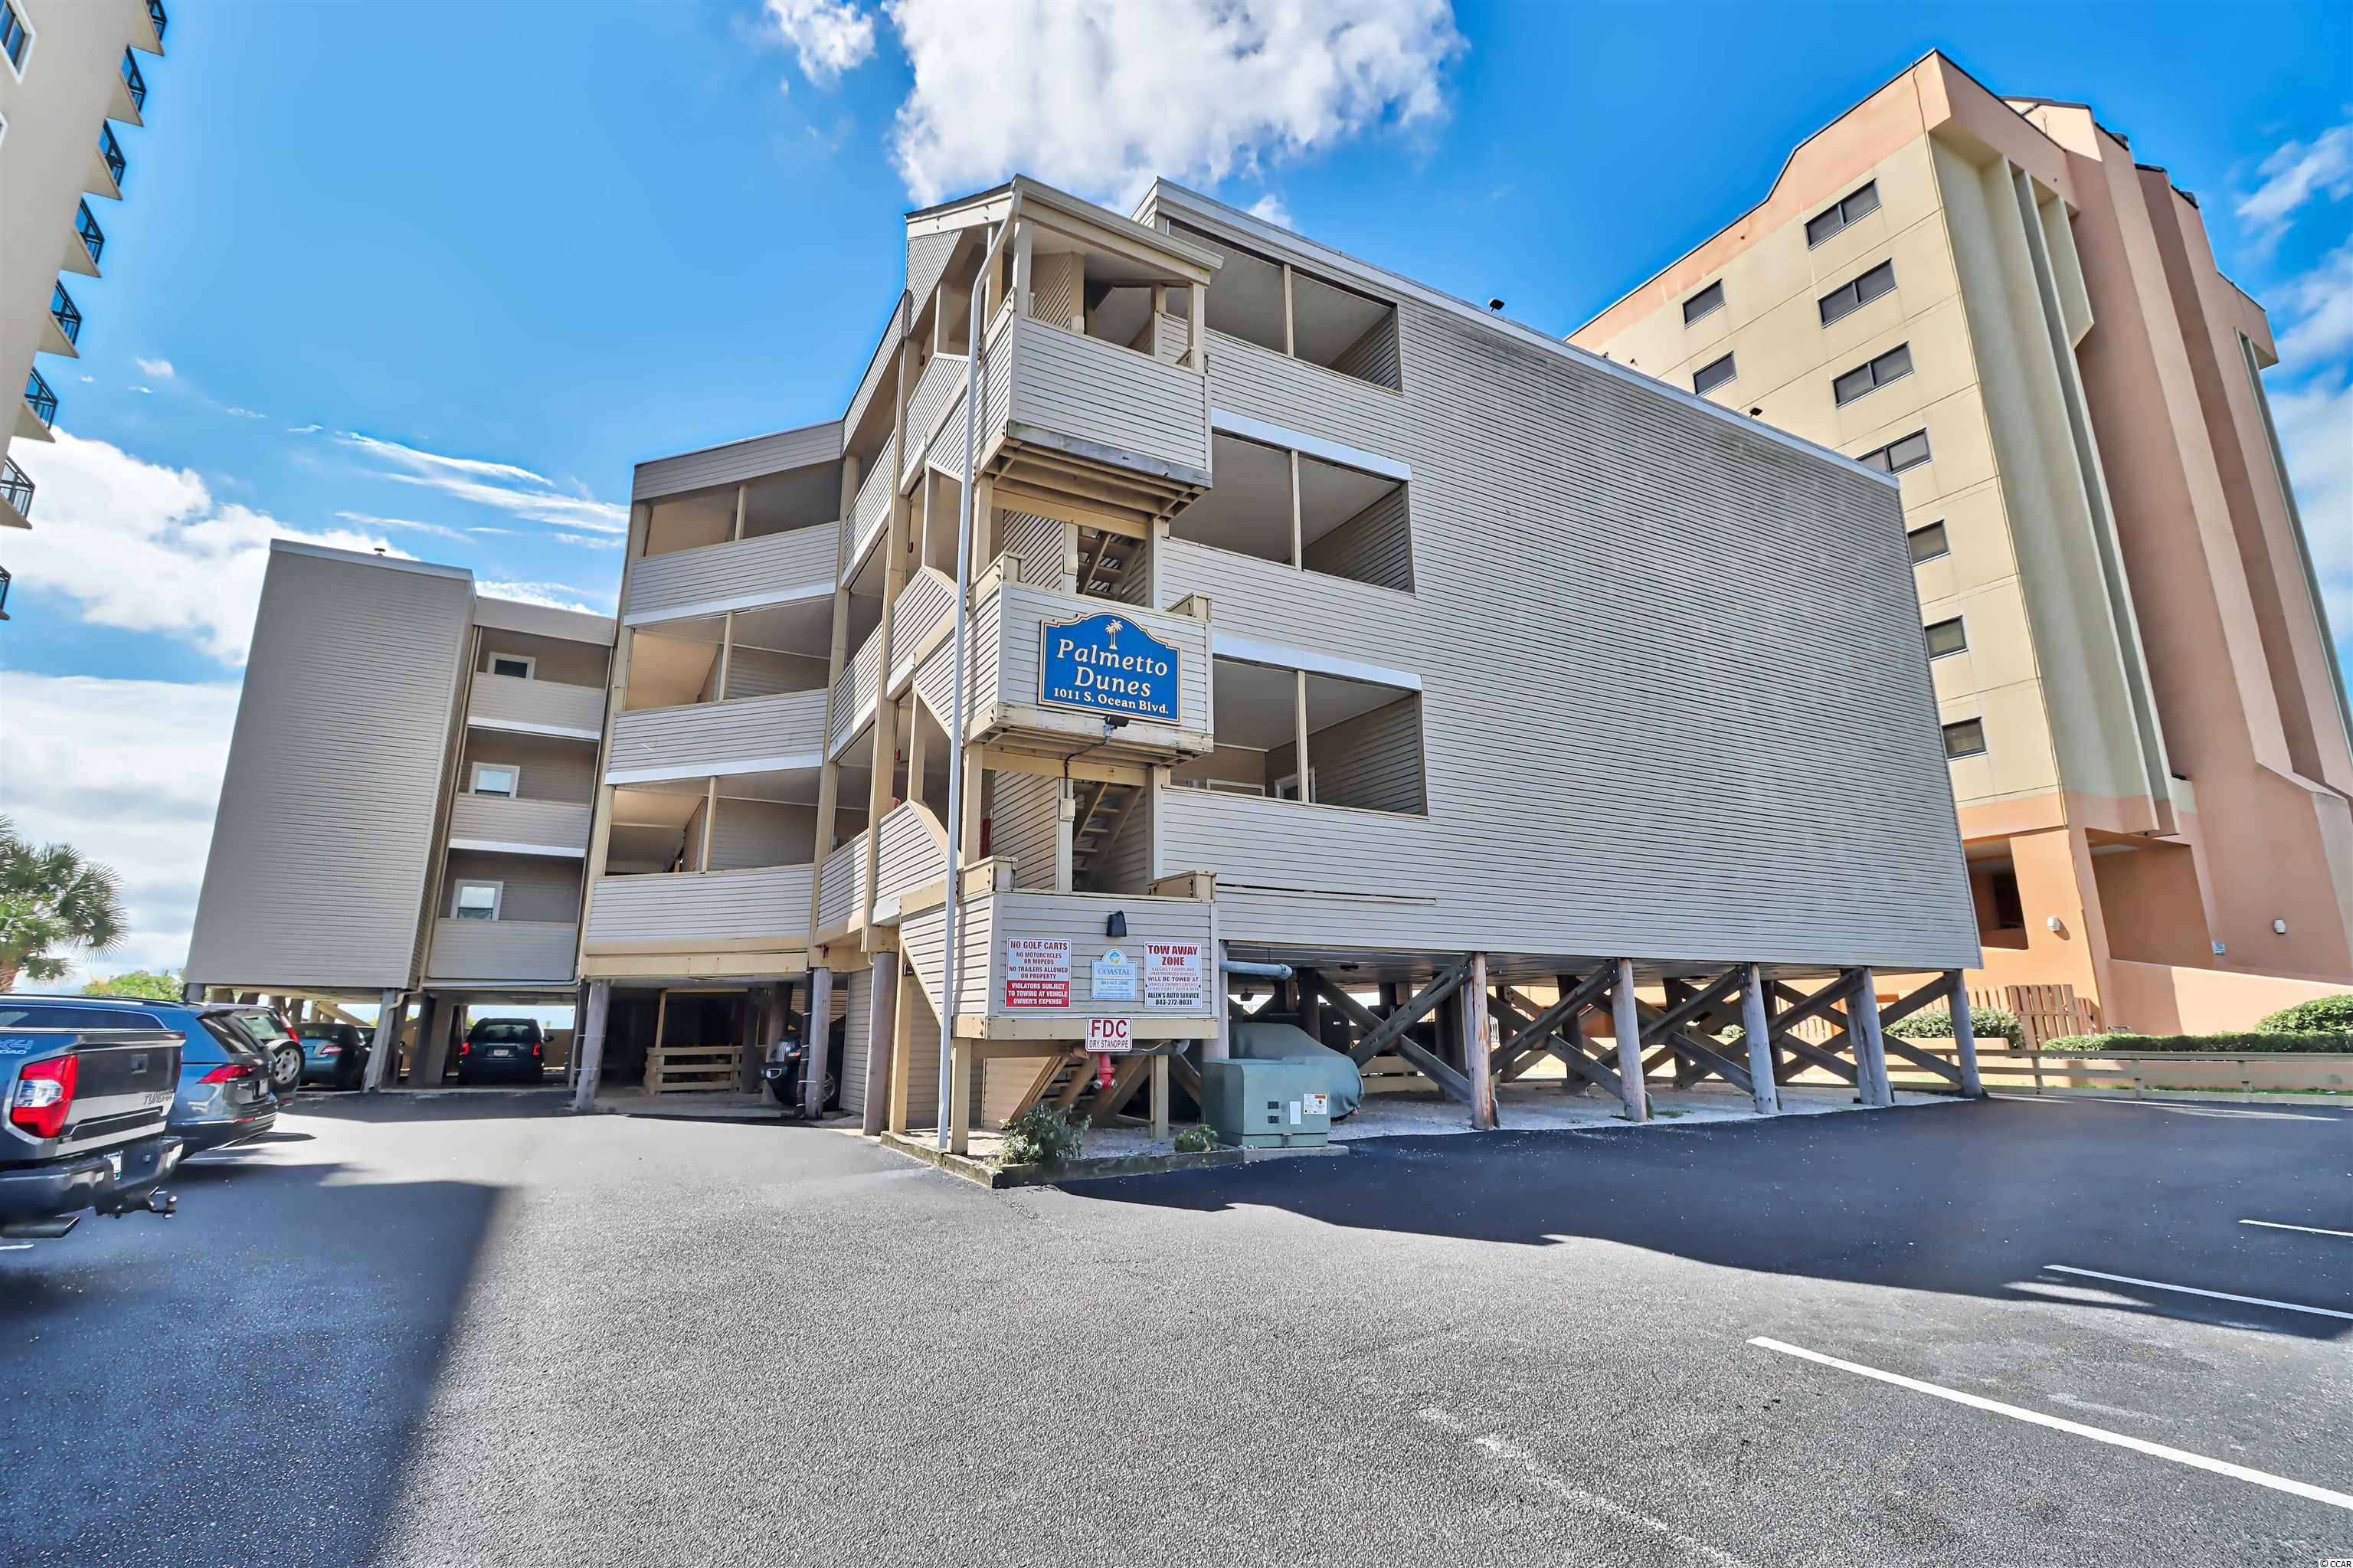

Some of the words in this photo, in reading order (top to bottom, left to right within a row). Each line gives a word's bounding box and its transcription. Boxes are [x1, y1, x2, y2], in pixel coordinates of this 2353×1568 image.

[1057, 638, 1168, 676] Palmetto
[1074, 666, 1151, 697] Dunes
[1053, 688, 1080, 700] 1011
[1083, 692, 1095, 702] S.
[1098, 693, 1136, 709] Ocean
[1139, 700, 1170, 714] Blvd.
[1010, 941, 1021, 949] NO
[1044, 942, 1068, 951] CARTS
[1147, 944, 1170, 954] TOW
[1171, 945, 1198, 955] AWAY
[1162, 956, 1185, 966] ZONE
[1091, 1020, 1127, 1038] FDC
[1089, 1039, 1100, 1048] DRY
[1101, 1039, 1128, 1048] STANDPIPE
[142, 1089, 174, 1106] TUNDRA
